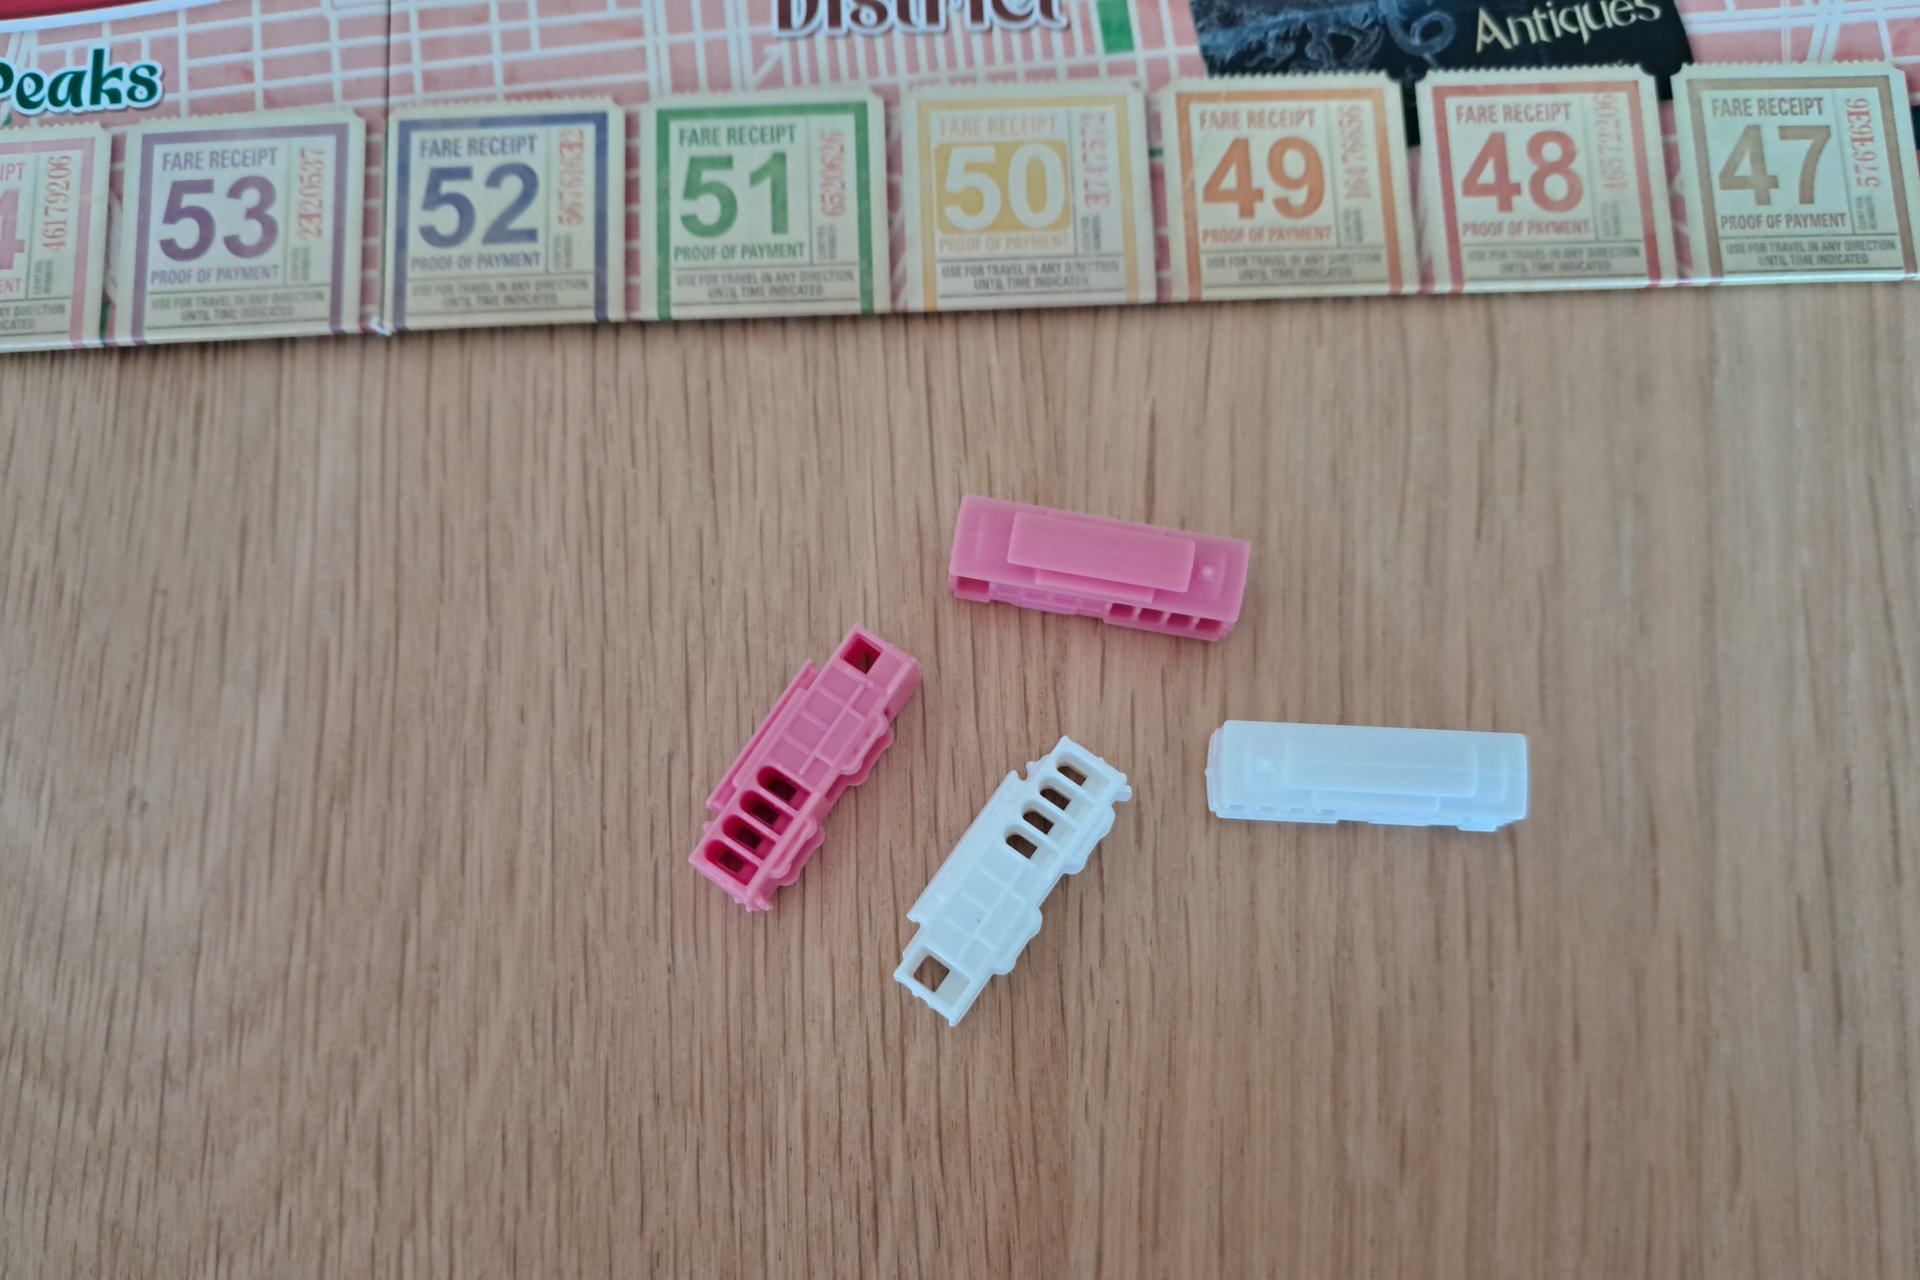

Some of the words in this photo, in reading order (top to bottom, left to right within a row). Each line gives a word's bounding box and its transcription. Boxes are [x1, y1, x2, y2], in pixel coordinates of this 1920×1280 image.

[1476, 0, 1662, 52] Antiques
[1456, 105, 1497, 124] FARE
[1503, 103, 1571, 123] RECEIPT
[1711, 98, 1752, 117] FARE
[1758, 97, 1823, 117] RECEIPT
[940, 117, 981, 137] FARE
[988, 115, 1056, 137] RECEIPT
[1200, 110, 1240, 131] FARE
[1247, 108, 1316, 129] RECEIPT
[679, 127, 721, 147] FARE
[727, 124, 796, 146] RECEIPT
[420, 138, 462, 158] FARE
[468, 135, 537, 156] RECEIPT
[162, 151, 203, 172] FARE
[210, 147, 278, 169] RECEIPT
[1718, 124, 1832, 206] 47
[1203, 136, 1325, 220] 49
[1461, 130, 1584, 213] 48
[680, 151, 789, 238] 51
[944, 143, 1065, 231] 50
[419, 163, 540, 249] 52
[159, 175, 279, 262] 53
[1462, 222, 1504, 237] PROOF
[1508, 222, 1523, 236] OF
[1528, 219, 1591, 235] PAYMENT
[1720, 215, 1763, 231] PROOF
[1767, 215, 1782, 229] OF
[1786, 213, 1846, 228] PAYMENT
[939, 237, 982, 253] PROOF
[985, 237, 1001, 251] OF
[1006, 234, 1069, 250] PAYMENT
[1202, 228, 1244, 244] PROOF
[1248, 228, 1263, 243] OF
[1268, 225, 1332, 241] PAYMENT
[674, 246, 717, 262] PROOF
[722, 245, 737, 260] OF
[741, 243, 805, 259] PAYMENT
[1770, 242, 1804, 254] TRAVEL
[1822, 241, 1841, 252] ANY
[1845, 240, 1896, 251] DIRECTION
[411, 256, 454, 271] PROOF
[458, 256, 474, 270] OF
[477, 252, 541, 268] PAYMENT
[987, 264, 1024, 277] TRAVEL
[1041, 262, 1061, 274] ANY
[1065, 261, 1119, 273] DIRECTION
[1759, 255, 1788, 267] UNTIL
[1792, 254, 1813, 265] TIME
[1817, 253, 1868, 265] INDICATED
[151, 270, 193, 284] PROOF
[197, 268, 213, 283] OF
[216, 265, 280, 281] PAYMENT
[974, 278, 1003, 291] UNTIL
[1008, 278, 1031, 289] TIME
[1035, 276, 1089, 288] INDICATED
